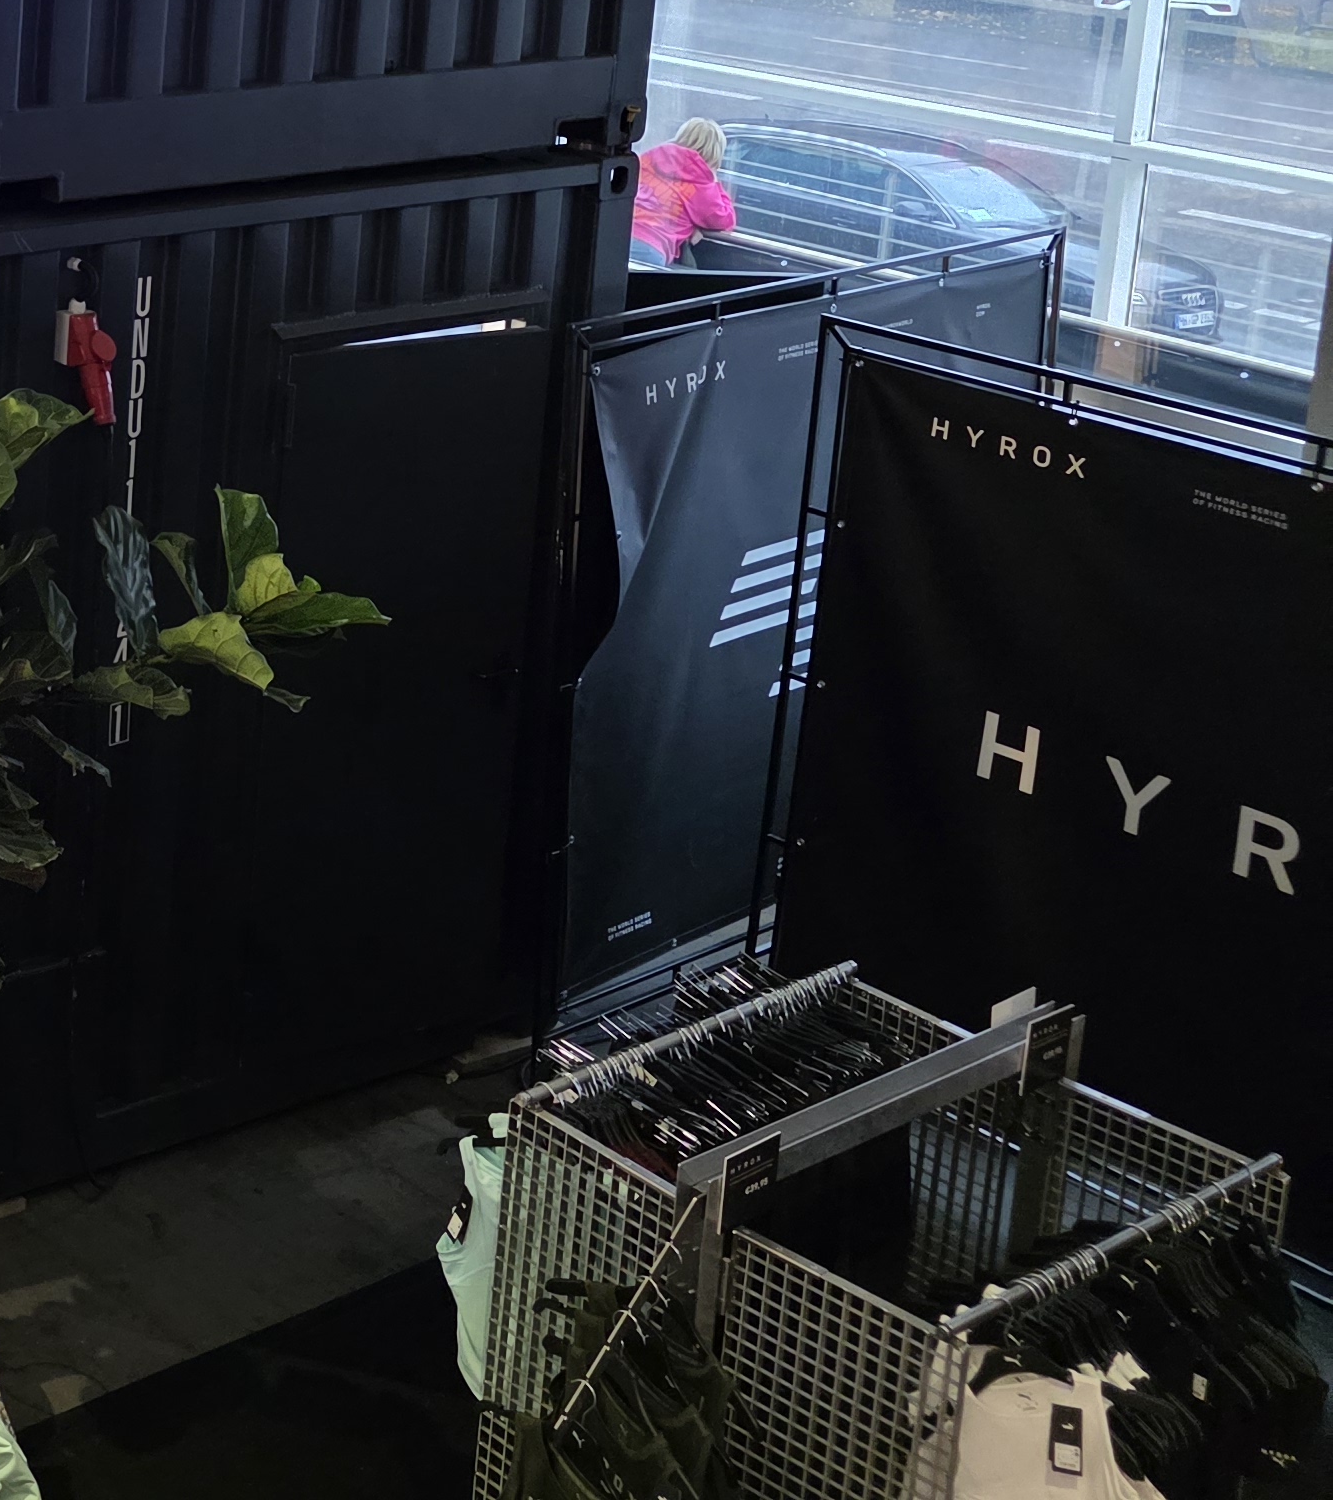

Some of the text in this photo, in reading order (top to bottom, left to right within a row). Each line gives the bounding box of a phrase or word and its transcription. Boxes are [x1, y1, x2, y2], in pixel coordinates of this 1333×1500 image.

[931, 416, 1086, 479] HYROX
[1192, 497, 1288, 530] OF FITNESS RACING
[1194, 489, 1287, 520] THE WORLD SERIES
[976, 709, 1301, 896] HYR
